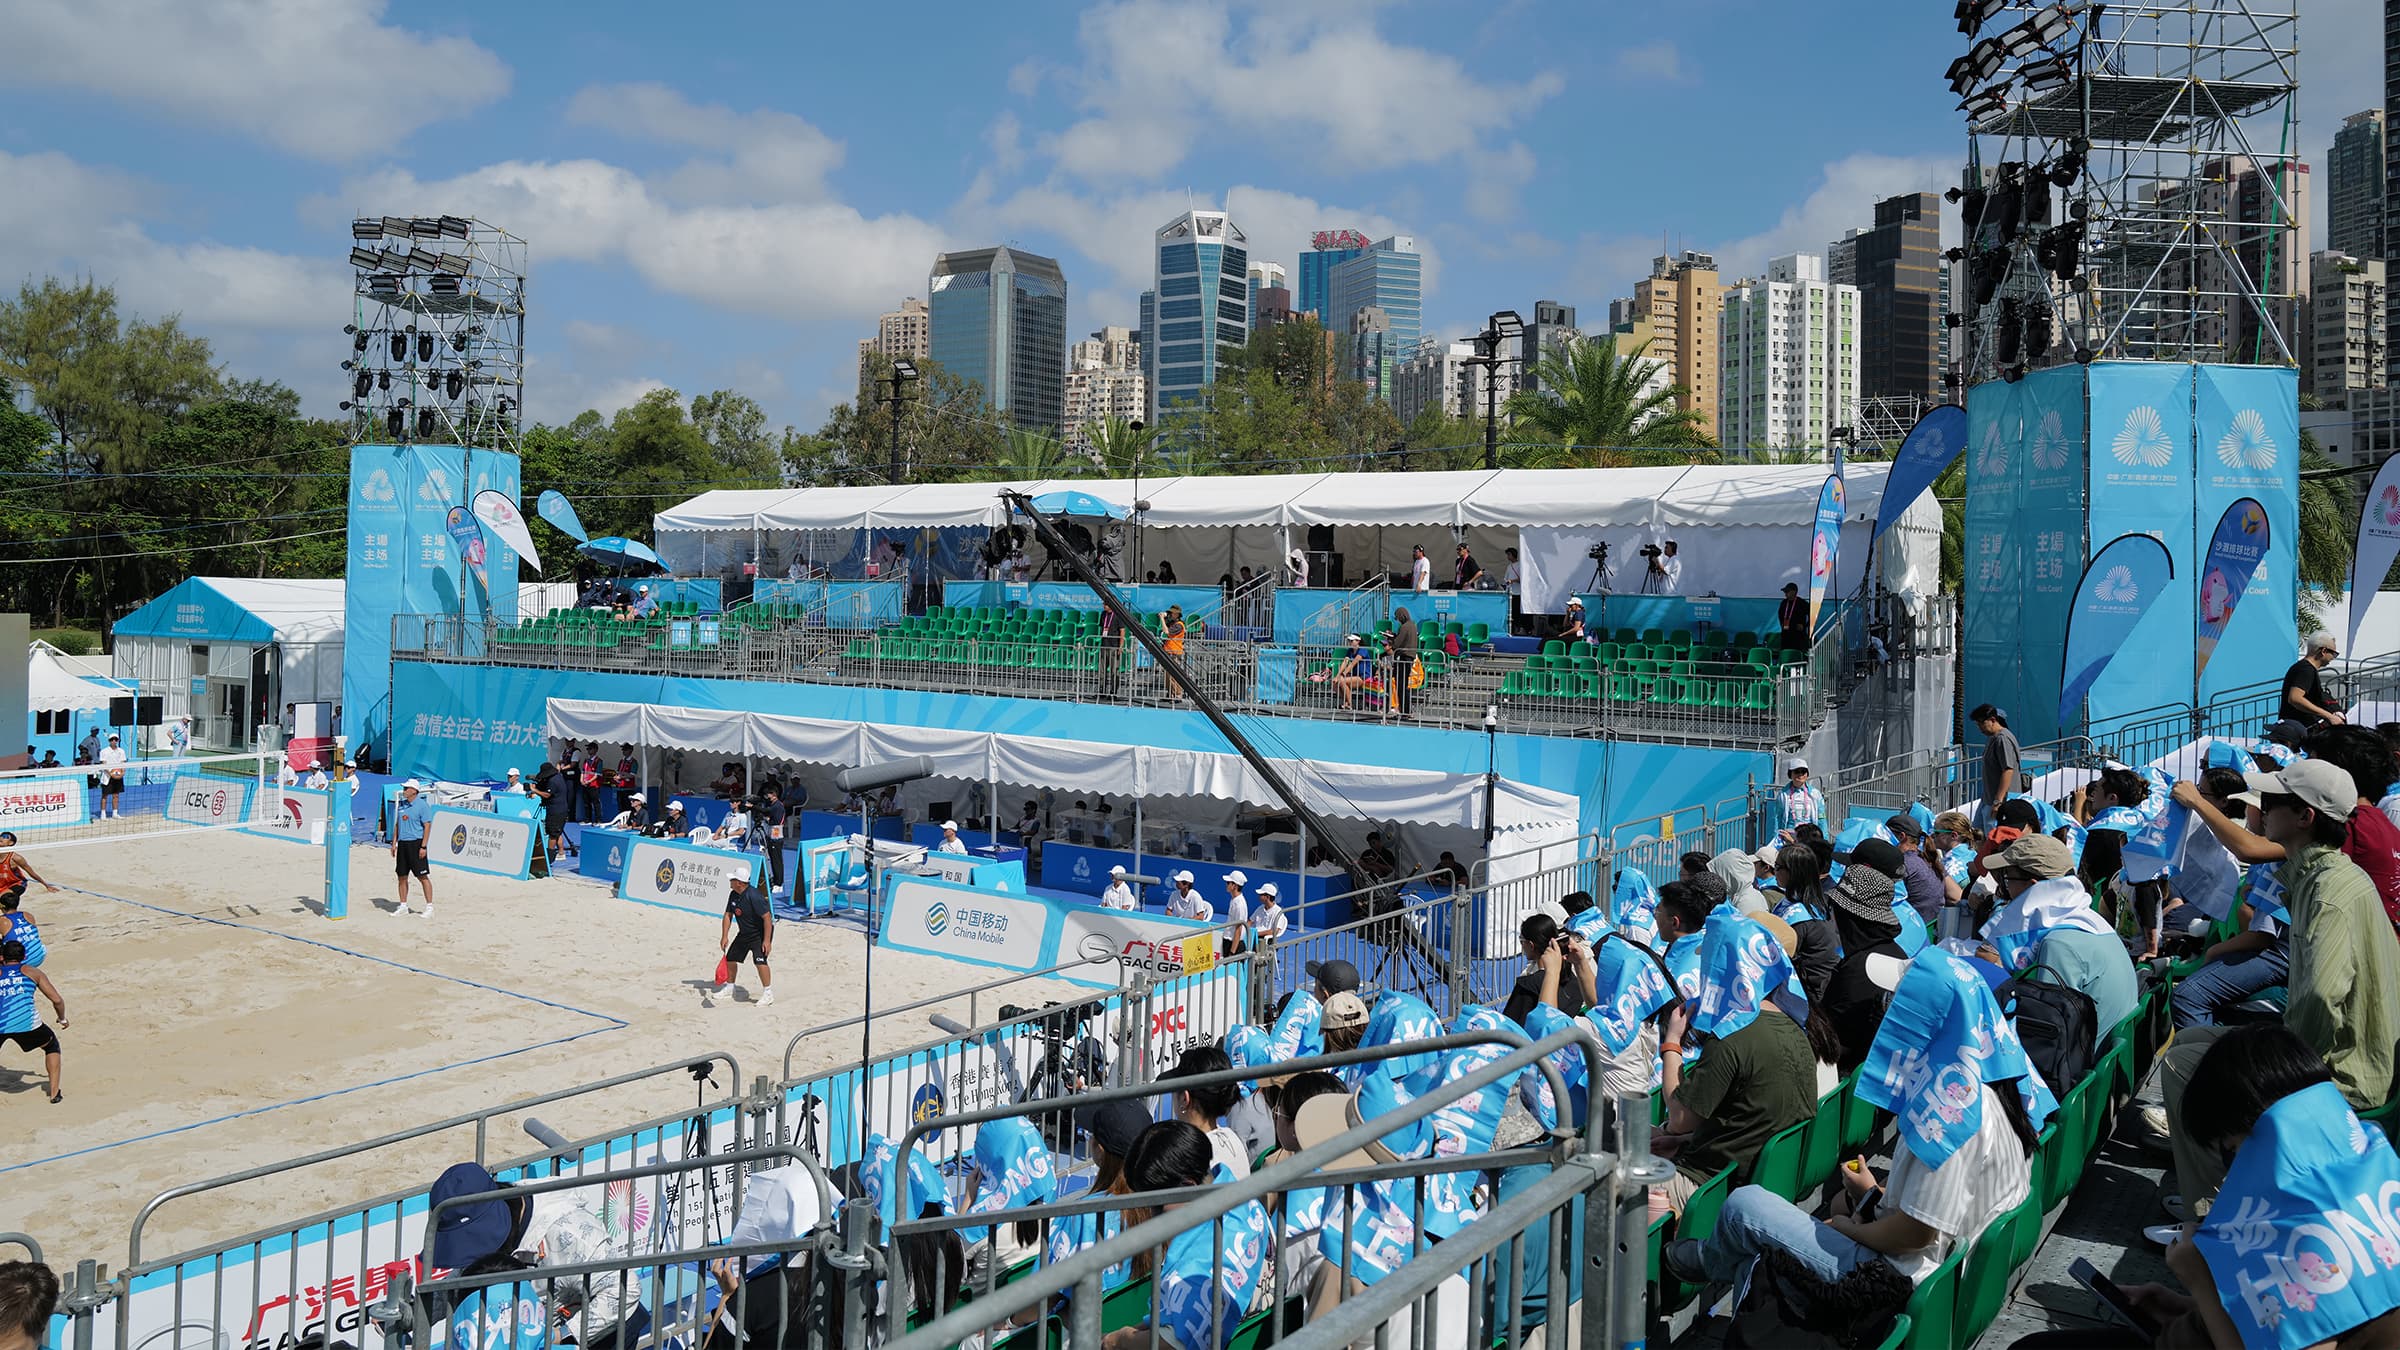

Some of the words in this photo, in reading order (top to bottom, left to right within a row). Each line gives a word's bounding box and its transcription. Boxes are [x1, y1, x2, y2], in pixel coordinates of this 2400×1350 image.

[1314, 230, 1352, 246] AIA
[413, 713, 486, 742] 激情全运会
[0, 792, 65, 808] 汽集团
[185, 791, 210, 809] ICBC
[14, 803, 67, 815] GROUP
[469, 837, 478, 846] The
[480, 838, 489, 849] Hong
[490, 840, 501, 850] Kong
[466, 848, 481, 858] Jockey
[482, 850, 493, 858] Club
[678, 873, 688, 883] The
[689, 874, 702, 887] Hong
[703, 877, 717, 889] Kong
[674, 885, 693, 898] Jockey
[694, 888, 707, 898] Club
[956, 908, 1009, 932] 中国移动
[953, 926, 976, 940] China
[977, 930, 1005, 945] Mobile
